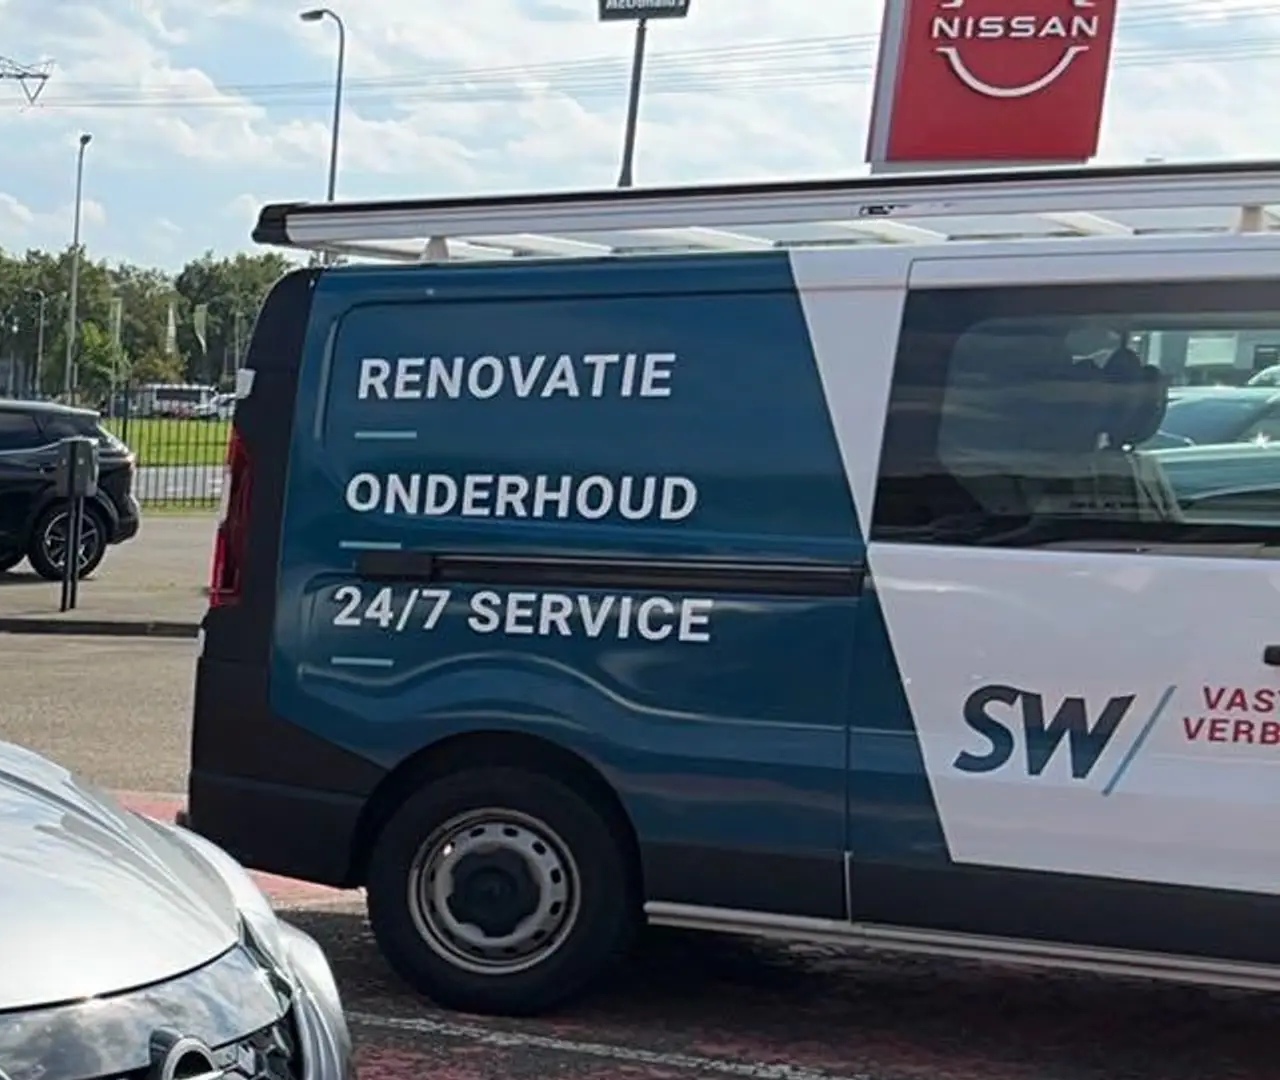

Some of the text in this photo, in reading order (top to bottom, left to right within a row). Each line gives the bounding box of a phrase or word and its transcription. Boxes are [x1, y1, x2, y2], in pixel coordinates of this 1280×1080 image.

[605, 0, 686, 9] McDonalds
[931, 16, 1099, 39] NISSAN
[357, 353, 677, 399] RENOVATIE
[345, 472, 698, 520] ONDERHOUD
[333, 586, 714, 642] 24/7 SERVICE
[1202, 686, 1280, 714] VAS
